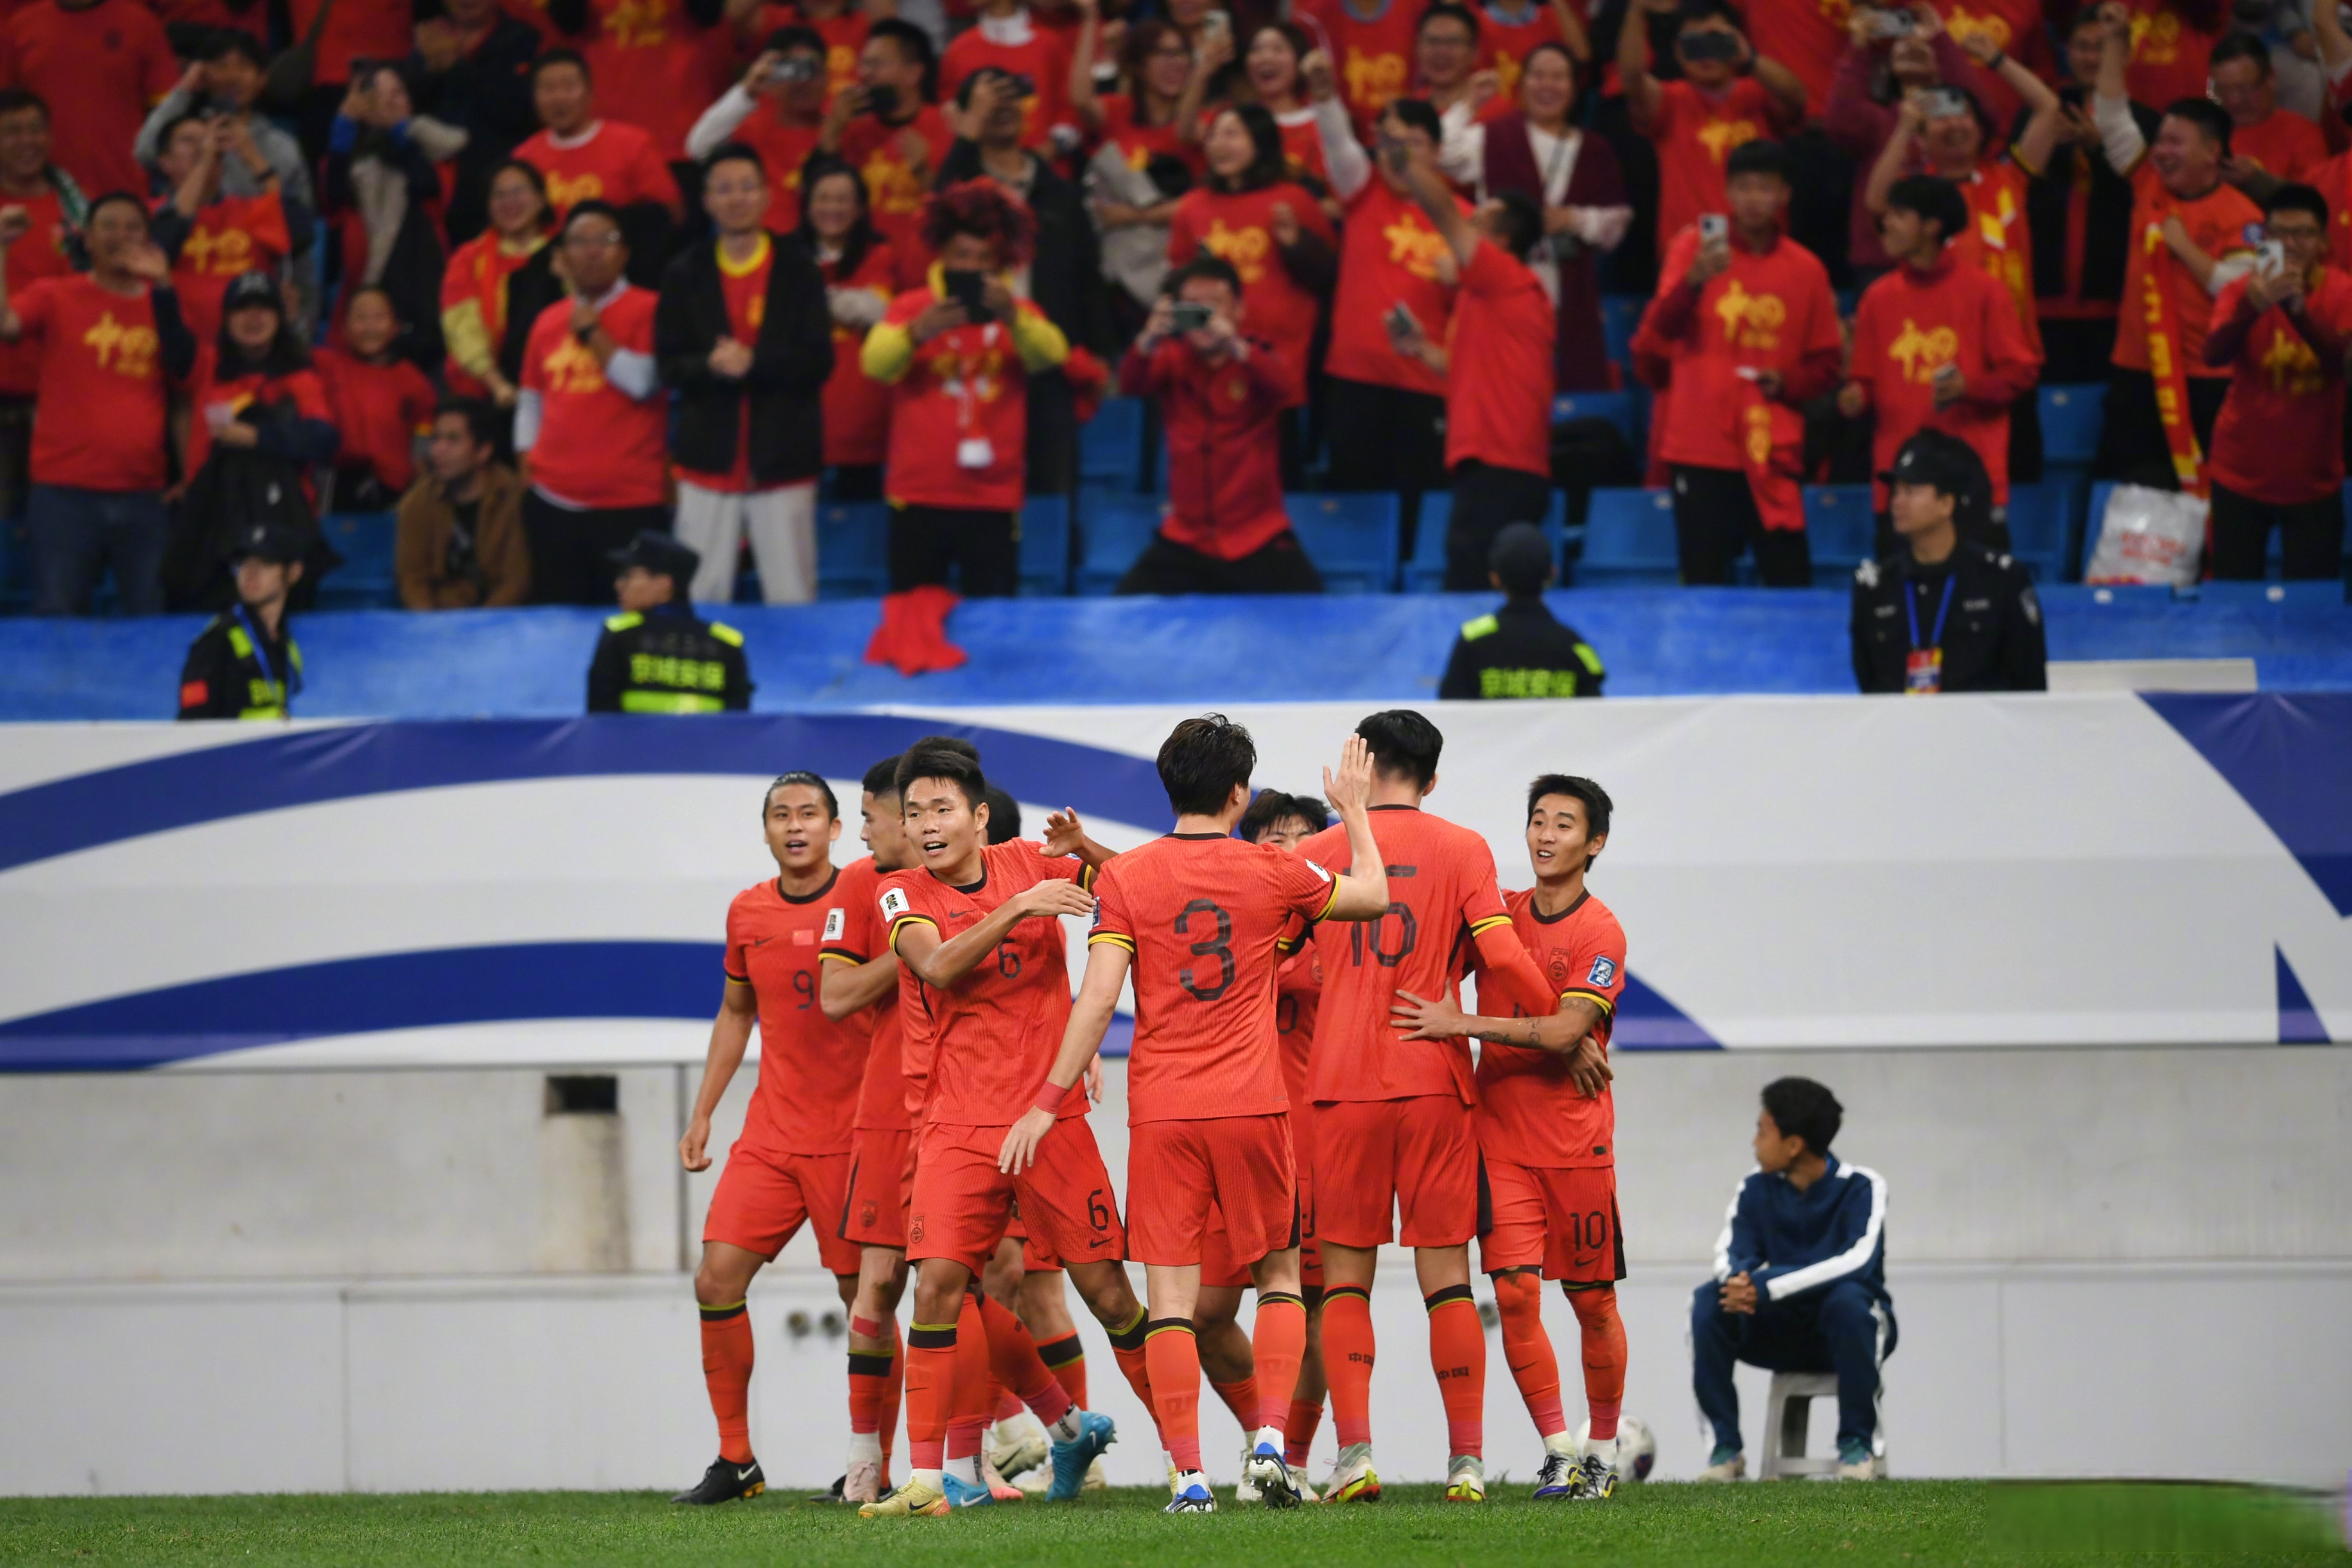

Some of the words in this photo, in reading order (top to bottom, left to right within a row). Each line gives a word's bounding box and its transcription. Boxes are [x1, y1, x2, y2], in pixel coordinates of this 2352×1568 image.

[997, 939, 1021, 979] 6
[1174, 899, 1235, 1002] 3
[793, 970, 814, 1010] 9
[1088, 1189, 1109, 1232] 6
[1570, 1210, 1606, 1252] 10
